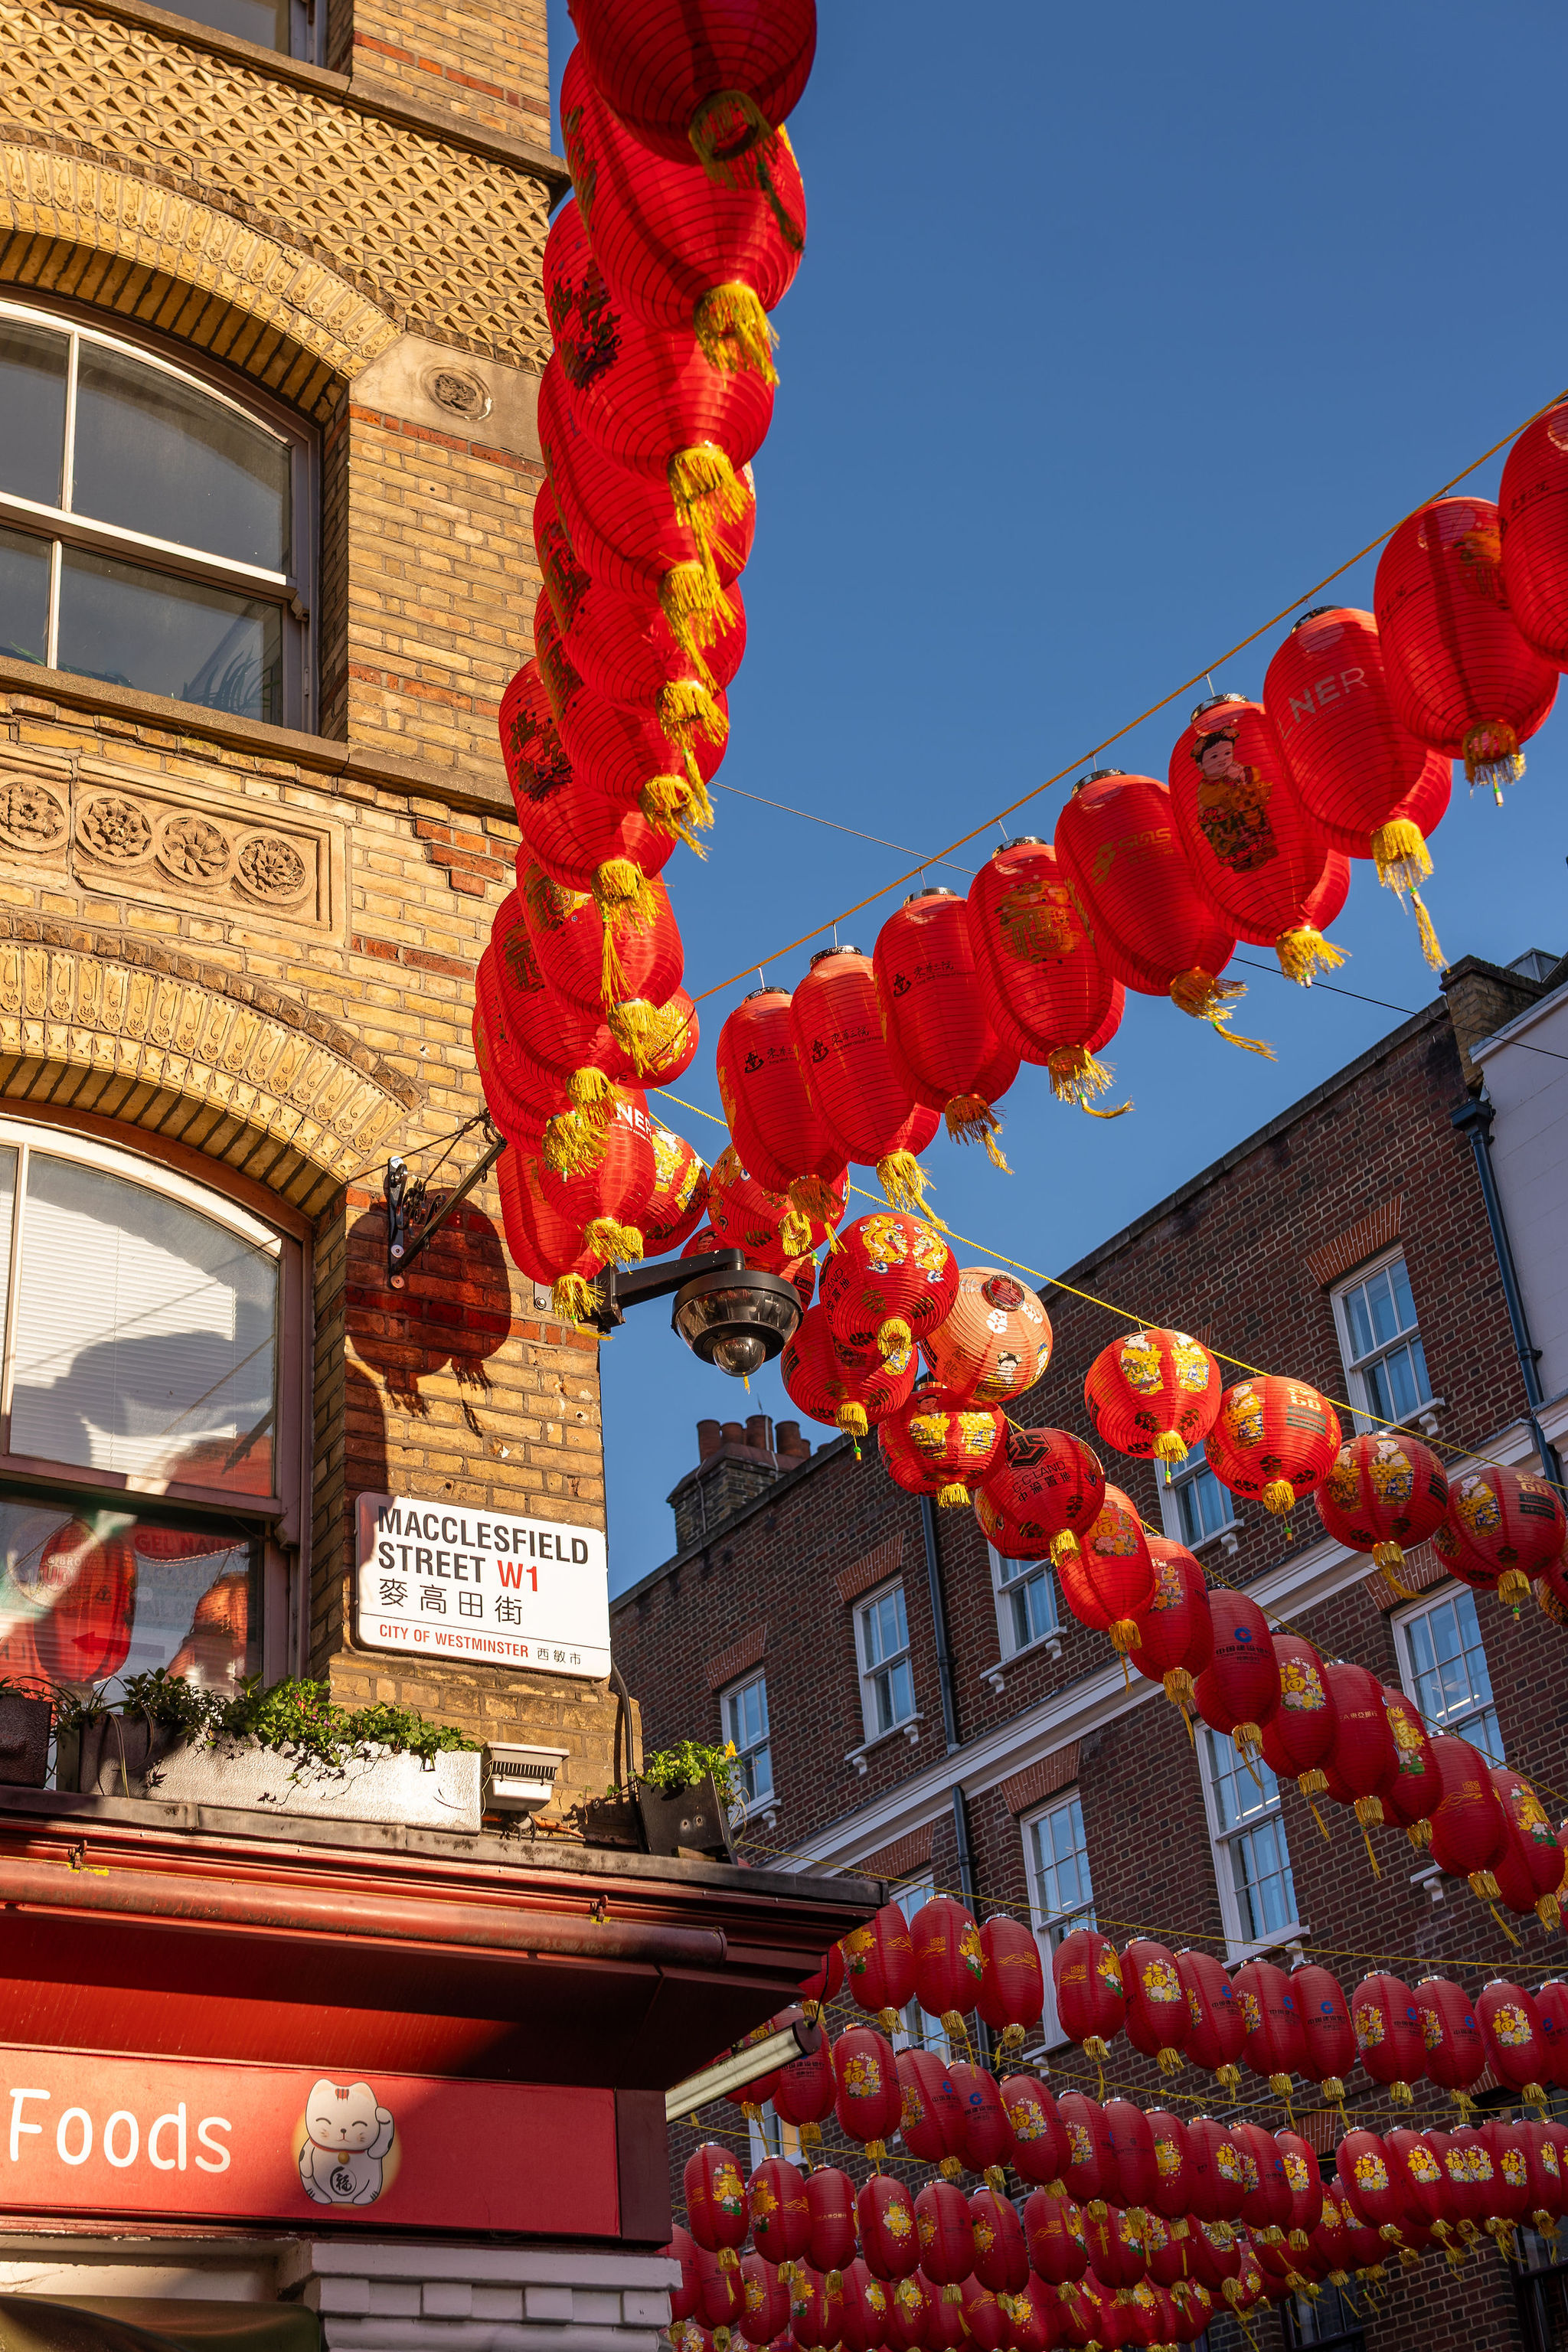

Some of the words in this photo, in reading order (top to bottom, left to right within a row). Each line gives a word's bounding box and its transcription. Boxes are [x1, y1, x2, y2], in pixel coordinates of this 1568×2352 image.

[1032, 1460, 1067, 1479] LAND
[378, 1505, 589, 1564] MACCLESFIELD
[378, 1541, 486, 1583] STREET
[497, 1560, 538, 1592] W1
[379, 1578, 523, 1625] 麥高田街
[380, 1624, 409, 1640] CITY
[413, 1628, 430, 1643] OF
[435, 1632, 529, 1658] WESTMINSTER
[536, 1647, 581, 1665] 西敏市
[9, 2088, 232, 2173] Foods
